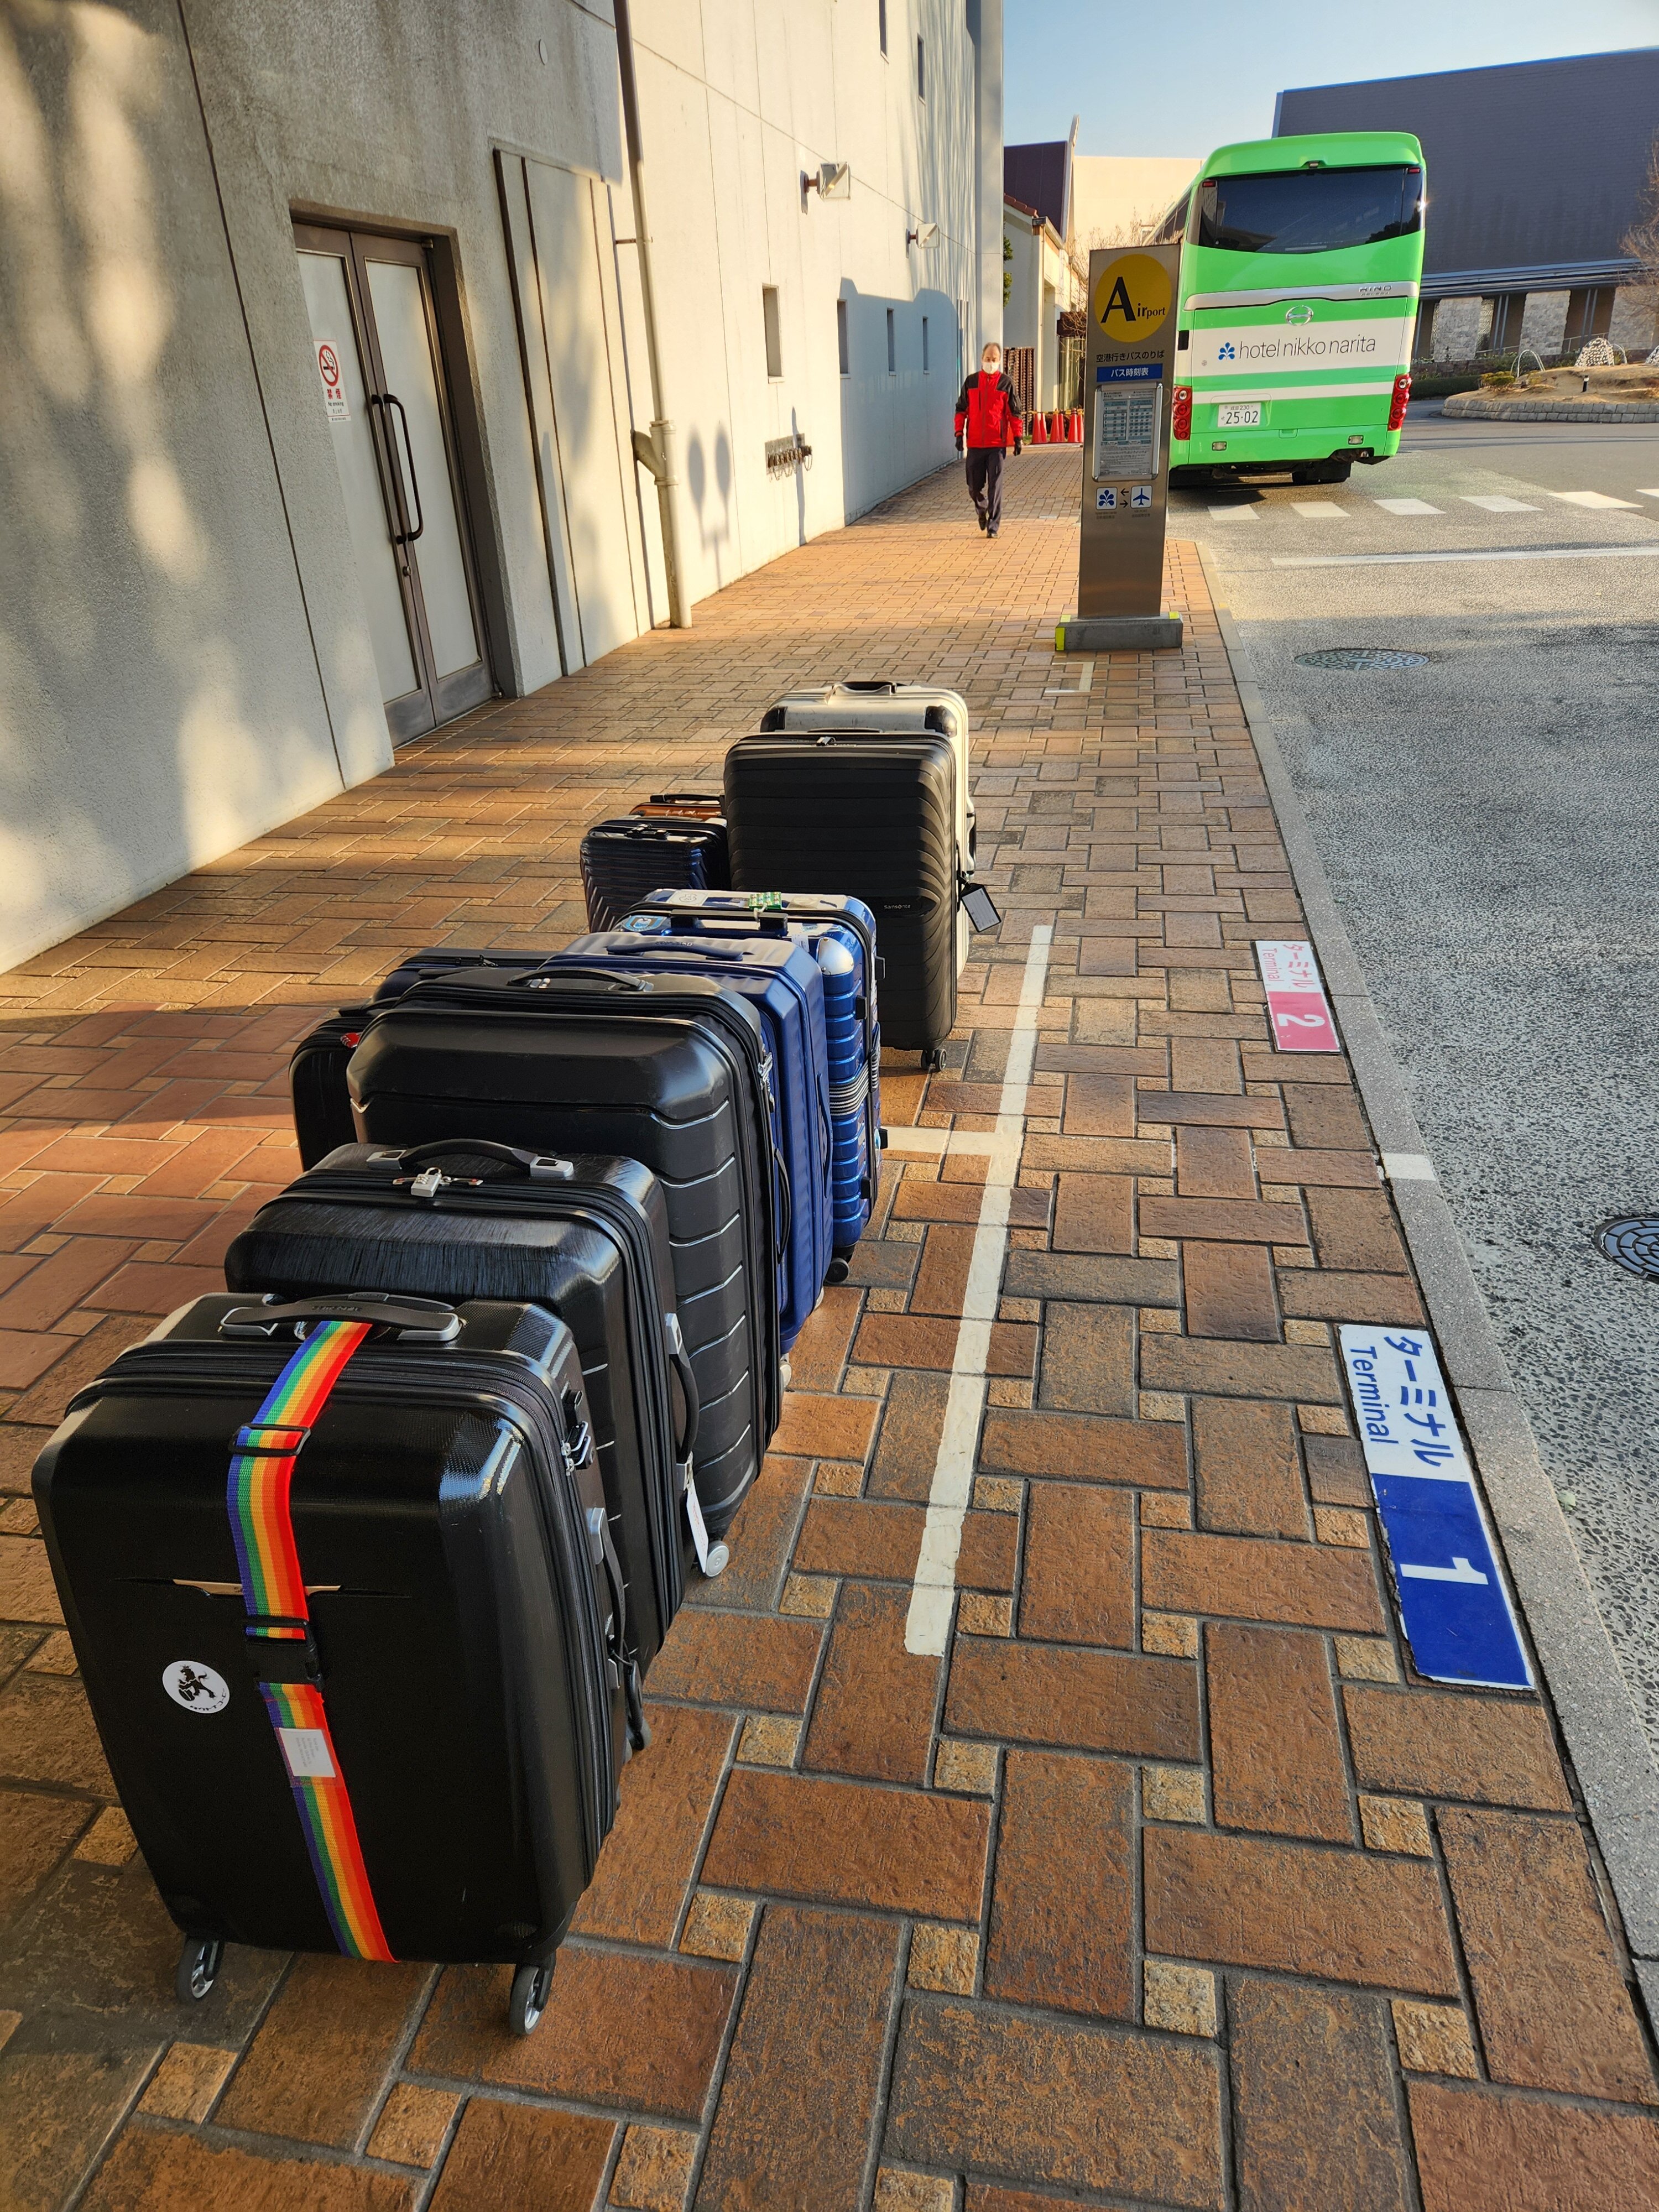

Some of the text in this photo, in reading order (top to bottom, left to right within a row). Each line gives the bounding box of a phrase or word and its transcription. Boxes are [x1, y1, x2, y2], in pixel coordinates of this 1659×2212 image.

[1100, 276, 1165, 323] Airport
[1096, 350, 1165, 362] 空港行きバスのりば
[1239, 334, 1376, 359] hotel nikko narita
[1111, 367, 1149, 378] バス時刻表
[1262, 948, 1284, 982] Terminal
[1283, 944, 1316, 988] ターミナル
[1277, 1013, 1325, 1027] 2
[1350, 1345, 1399, 1444] Terminal
[1384, 1335, 1454, 1467] ターミナル
[1400, 1557, 1489, 1585] 1
